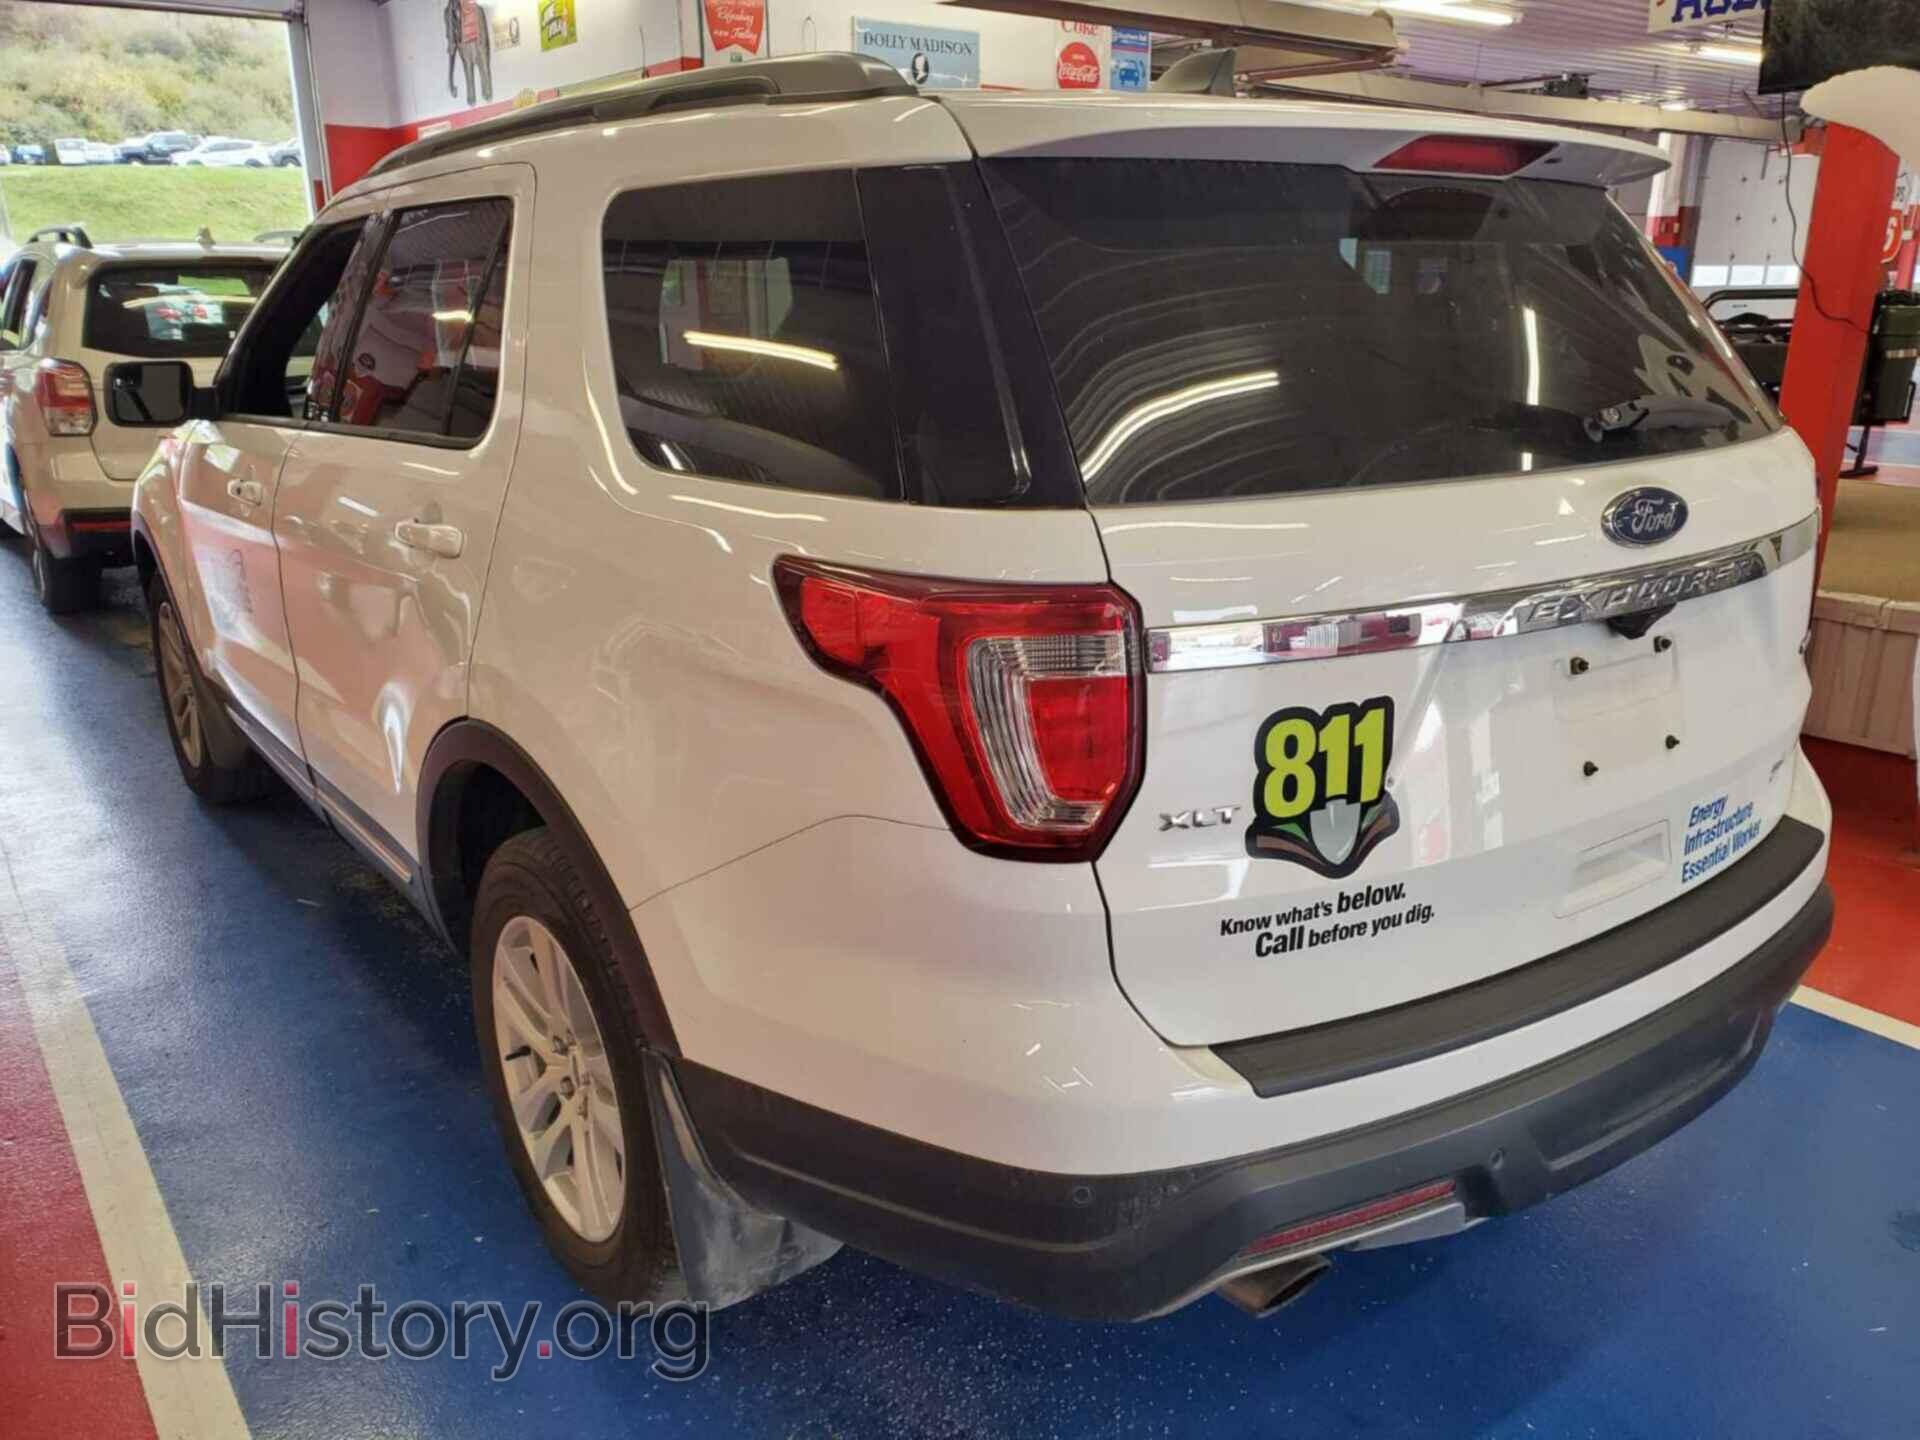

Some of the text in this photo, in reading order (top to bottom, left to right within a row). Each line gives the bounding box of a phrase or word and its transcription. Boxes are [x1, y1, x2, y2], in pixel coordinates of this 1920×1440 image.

[863, 31, 973, 57] DOLLY MADISON
[1630, 497, 1681, 534] Ford
[1529, 558, 1757, 623] EXPLORER
[1262, 707, 1386, 819] 811
[1157, 806, 1241, 832] XLT
[1684, 801, 1754, 857] Infrastructure
[1688, 793, 1729, 828] Energy
[1681, 819, 1762, 884] Essential Worker
[1219, 882, 1407, 937] Know what's below.
[1254, 903, 1435, 958] Call before you dig.
